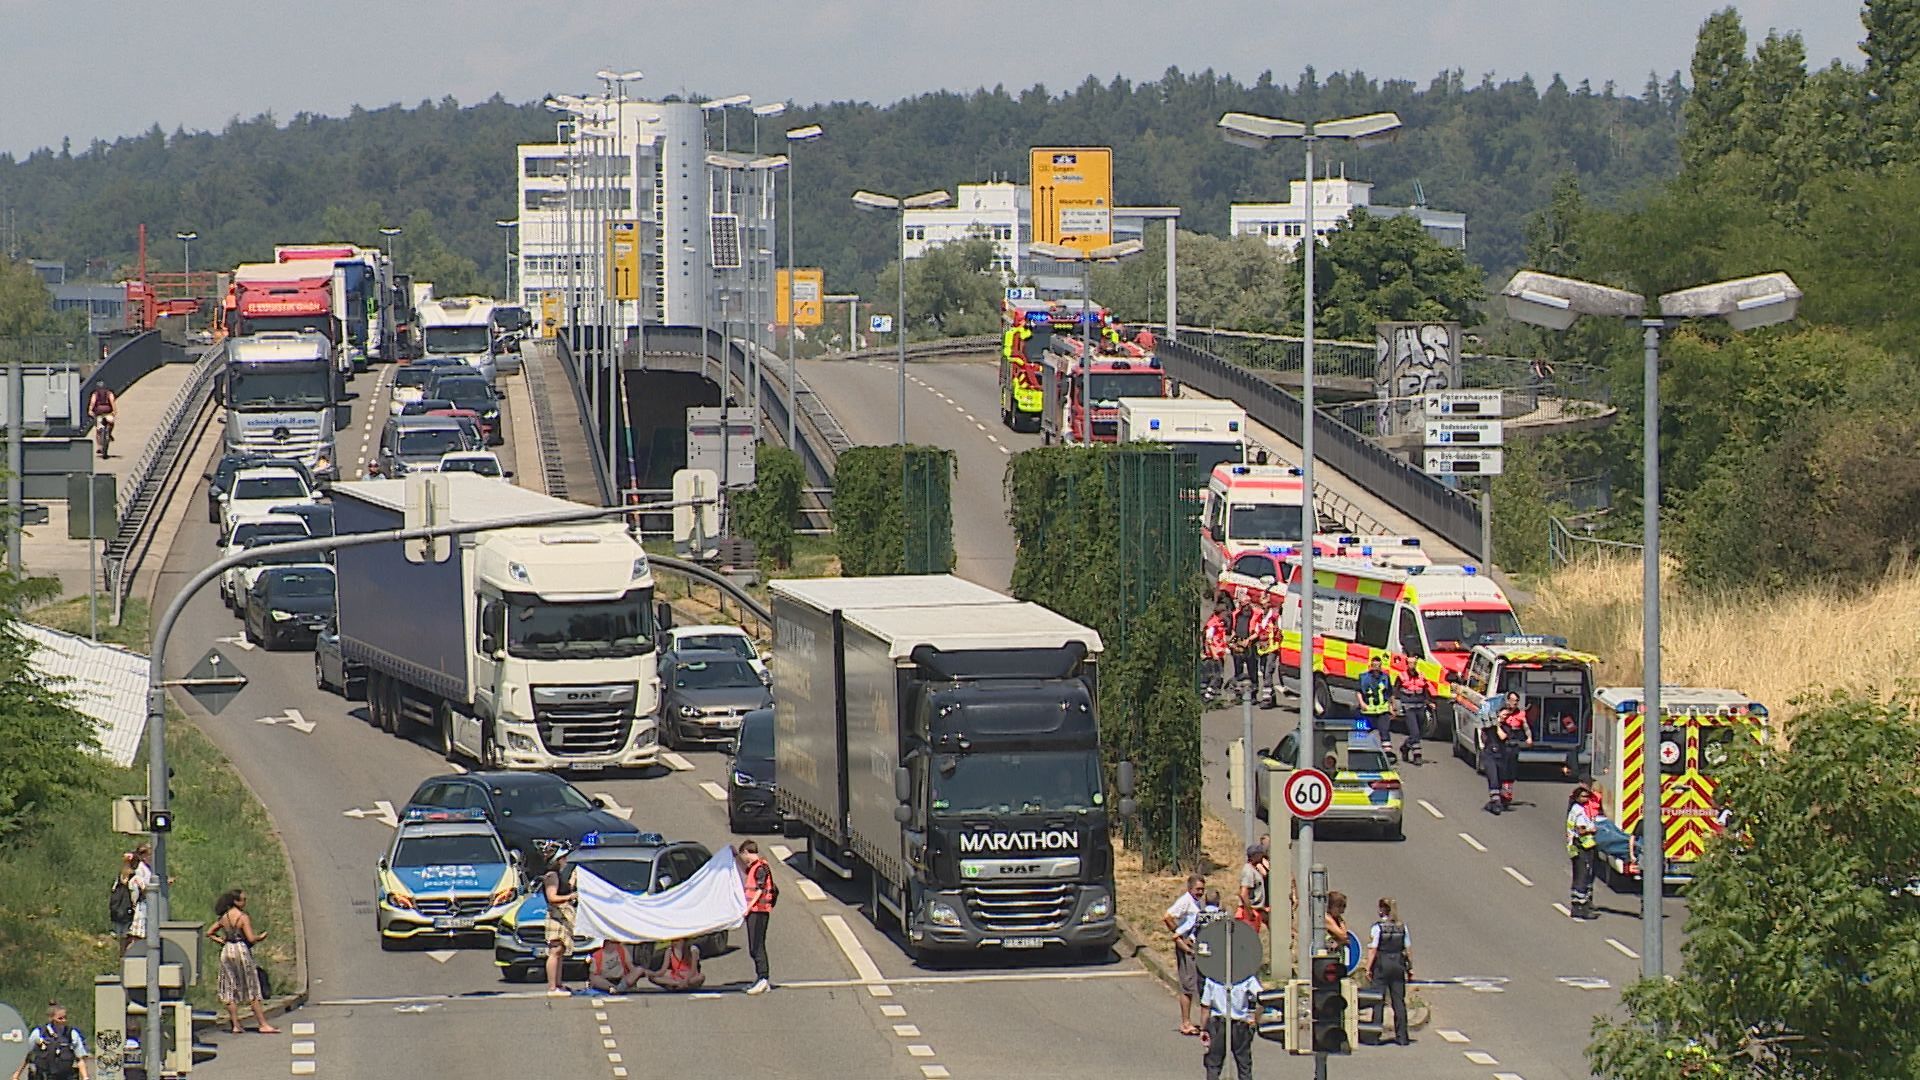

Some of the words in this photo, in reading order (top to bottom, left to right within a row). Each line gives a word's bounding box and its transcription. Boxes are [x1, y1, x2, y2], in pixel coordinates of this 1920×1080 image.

[1504, 637, 1544, 645] NOTARZT
[567, 691, 602, 700] DAF
[1295, 783, 1322, 804] 60
[960, 831, 1079, 852] MARATHON
[999, 865, 1040, 874] DAF
